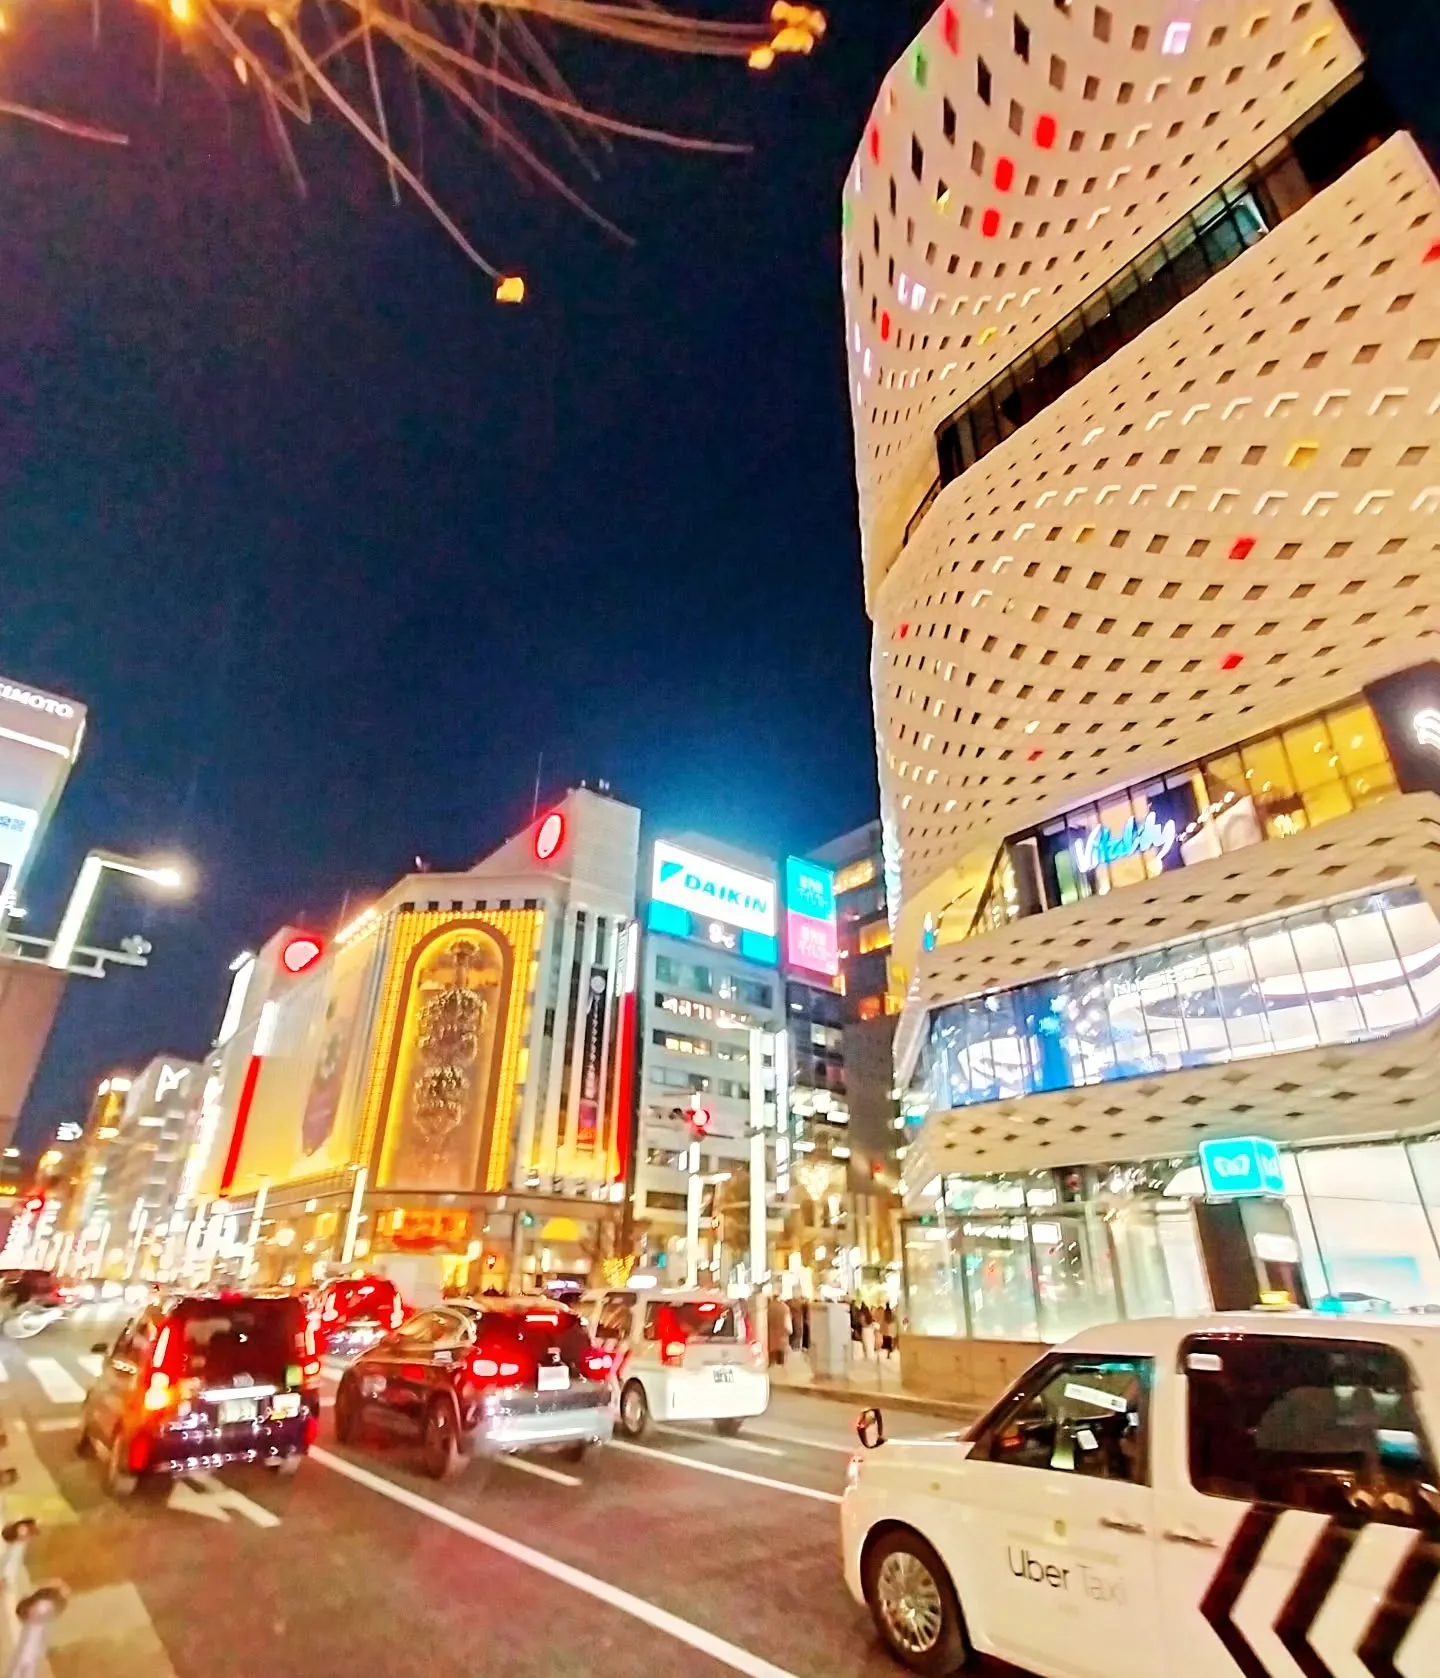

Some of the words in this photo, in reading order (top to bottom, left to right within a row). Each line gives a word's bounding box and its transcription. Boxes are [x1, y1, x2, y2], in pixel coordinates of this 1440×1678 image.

[0, 683, 74, 718] IMOTO
[684, 873, 767, 914] DAIKIN
[1007, 1545, 1070, 1591] Uber
[1076, 1563, 1128, 1607] Taxi
